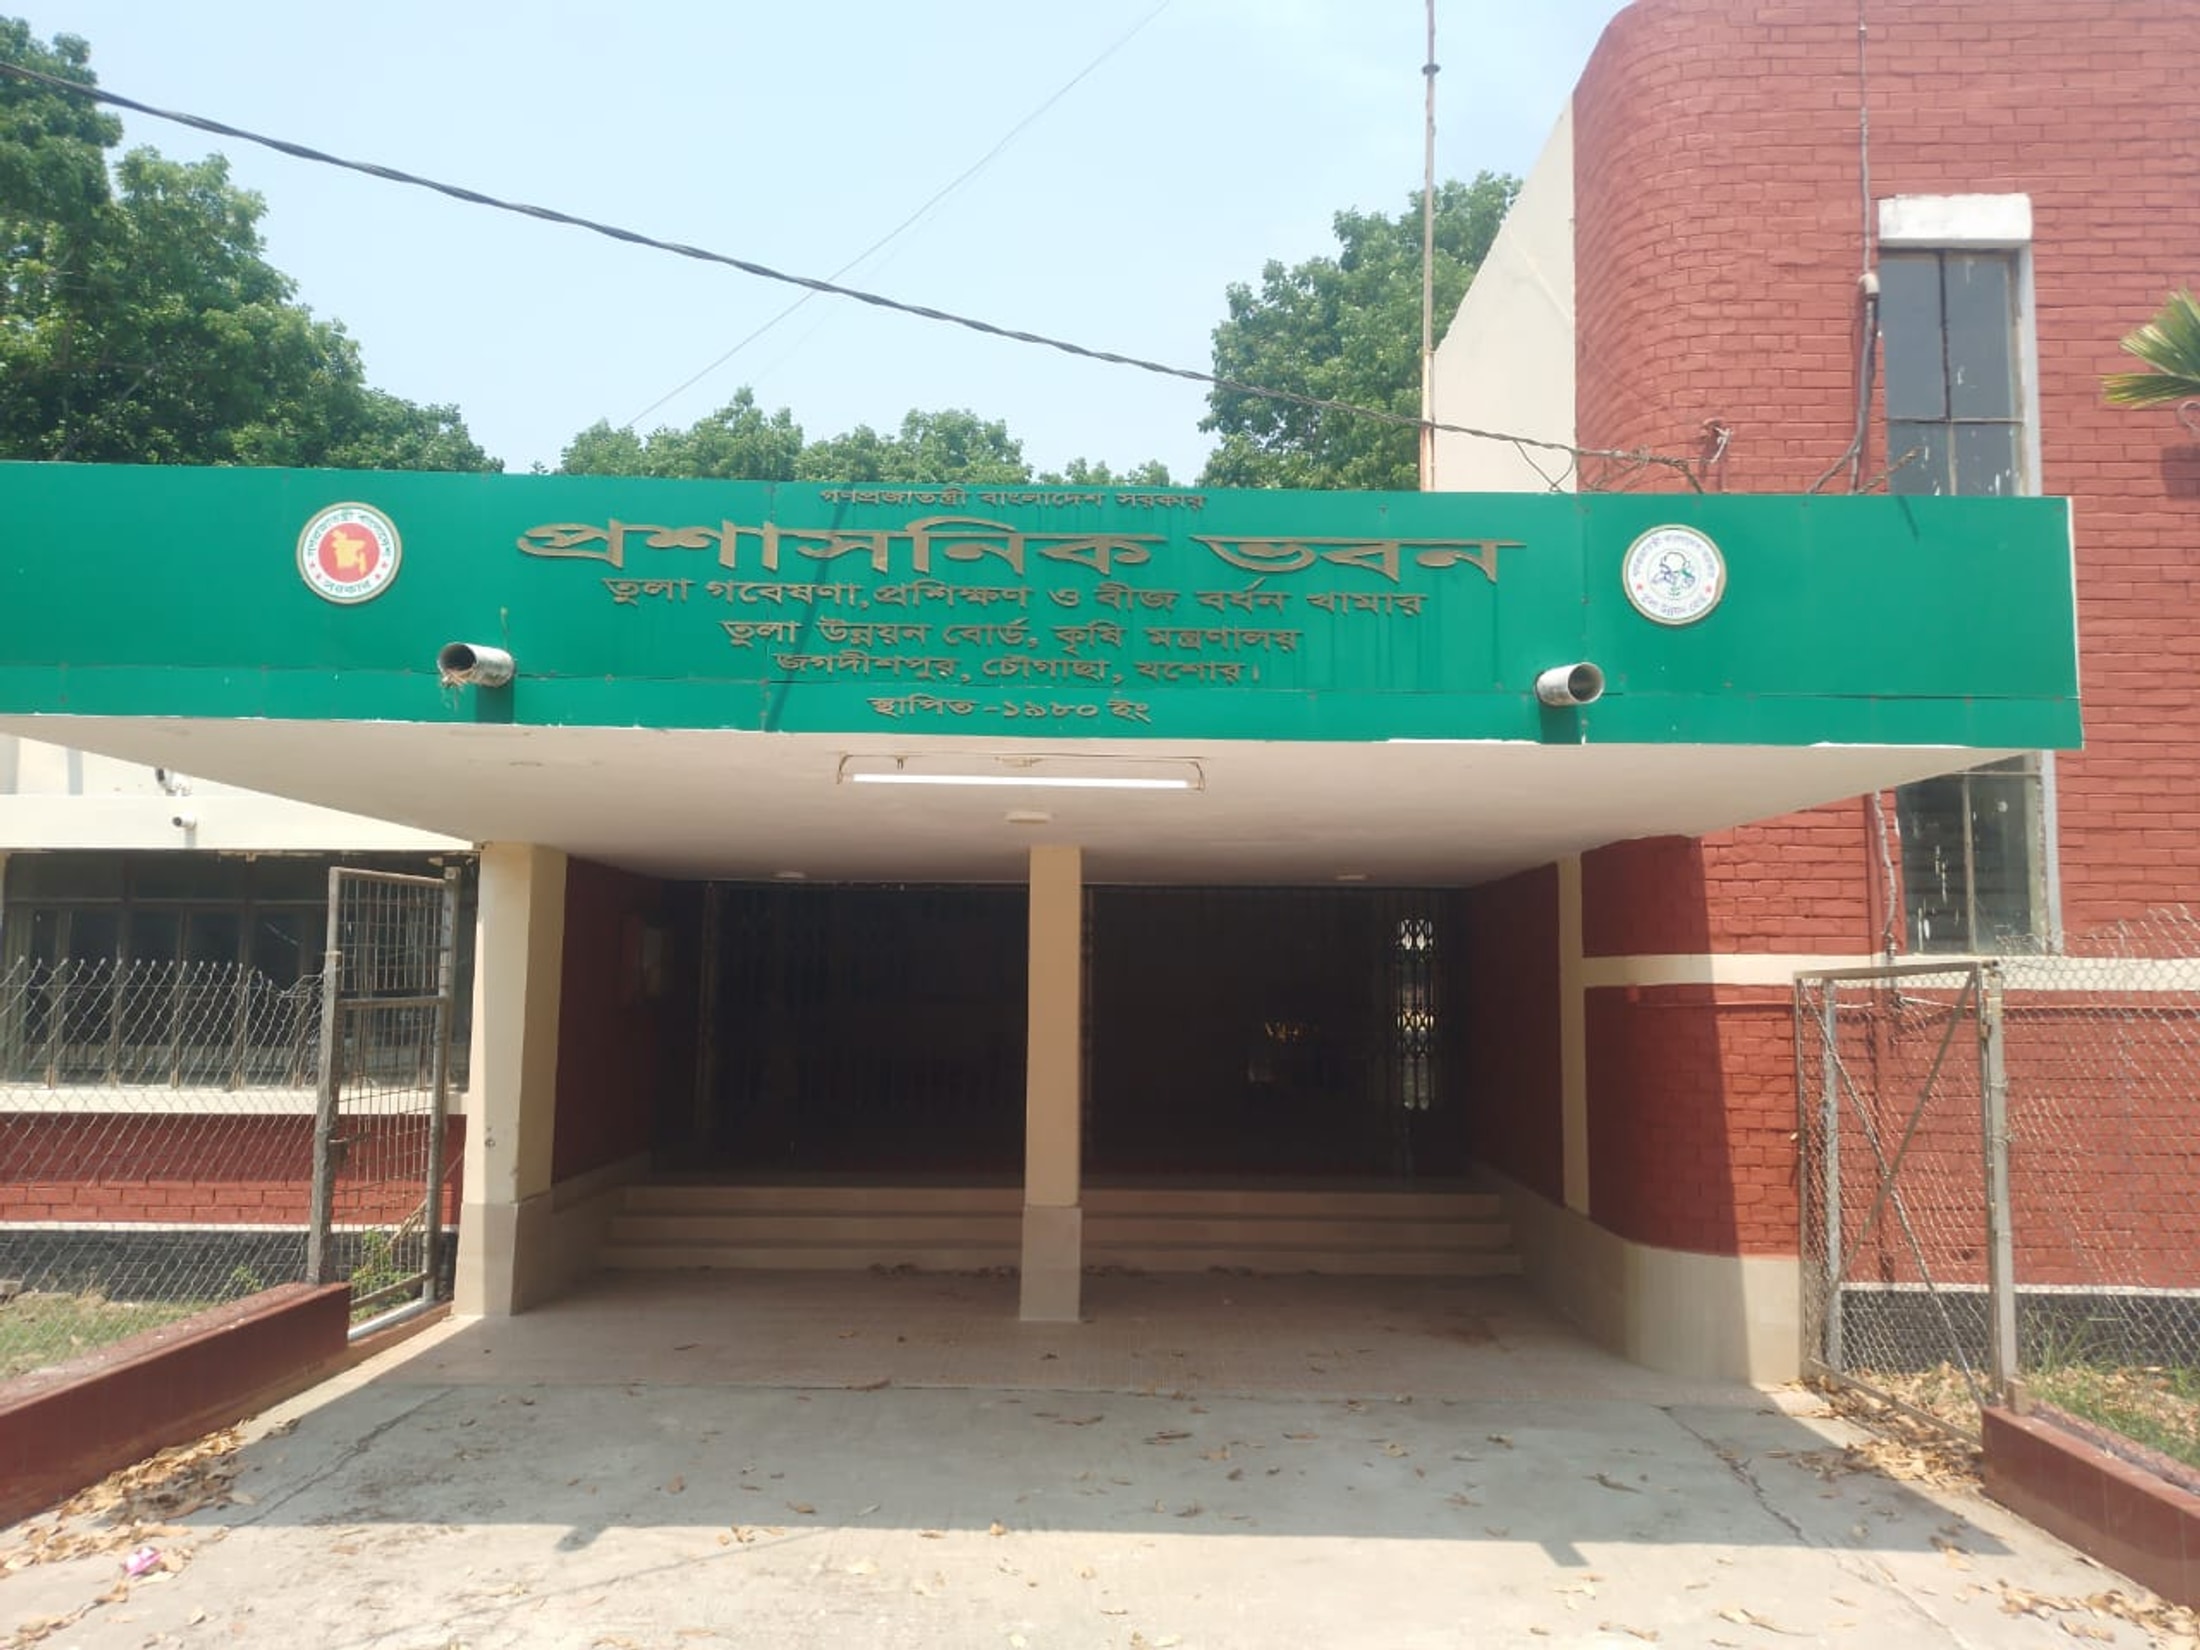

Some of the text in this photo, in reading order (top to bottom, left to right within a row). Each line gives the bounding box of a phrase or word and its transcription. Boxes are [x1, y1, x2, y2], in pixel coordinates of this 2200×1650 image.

[978, 490, 1105, 508] বাংলাদেশ
[1115, 492, 1206, 511] সরকার
[516, 515, 1525, 582] প্রশাসনিক ভবন
[602, 577, 694, 606] তুলা
[1049, 588, 1080, 607] ও
[1095, 582, 1180, 611] বীজ
[1195, 577, 1289, 614] বর্ধন
[1305, 590, 1427, 616] খামার
[720, 619, 801, 647] তুলা
[817, 616, 932, 647] উন্নয়ন
[1051, 620, 1126, 657] কৃষি
[1143, 626, 1302, 652] মন্ত্রণালয়
